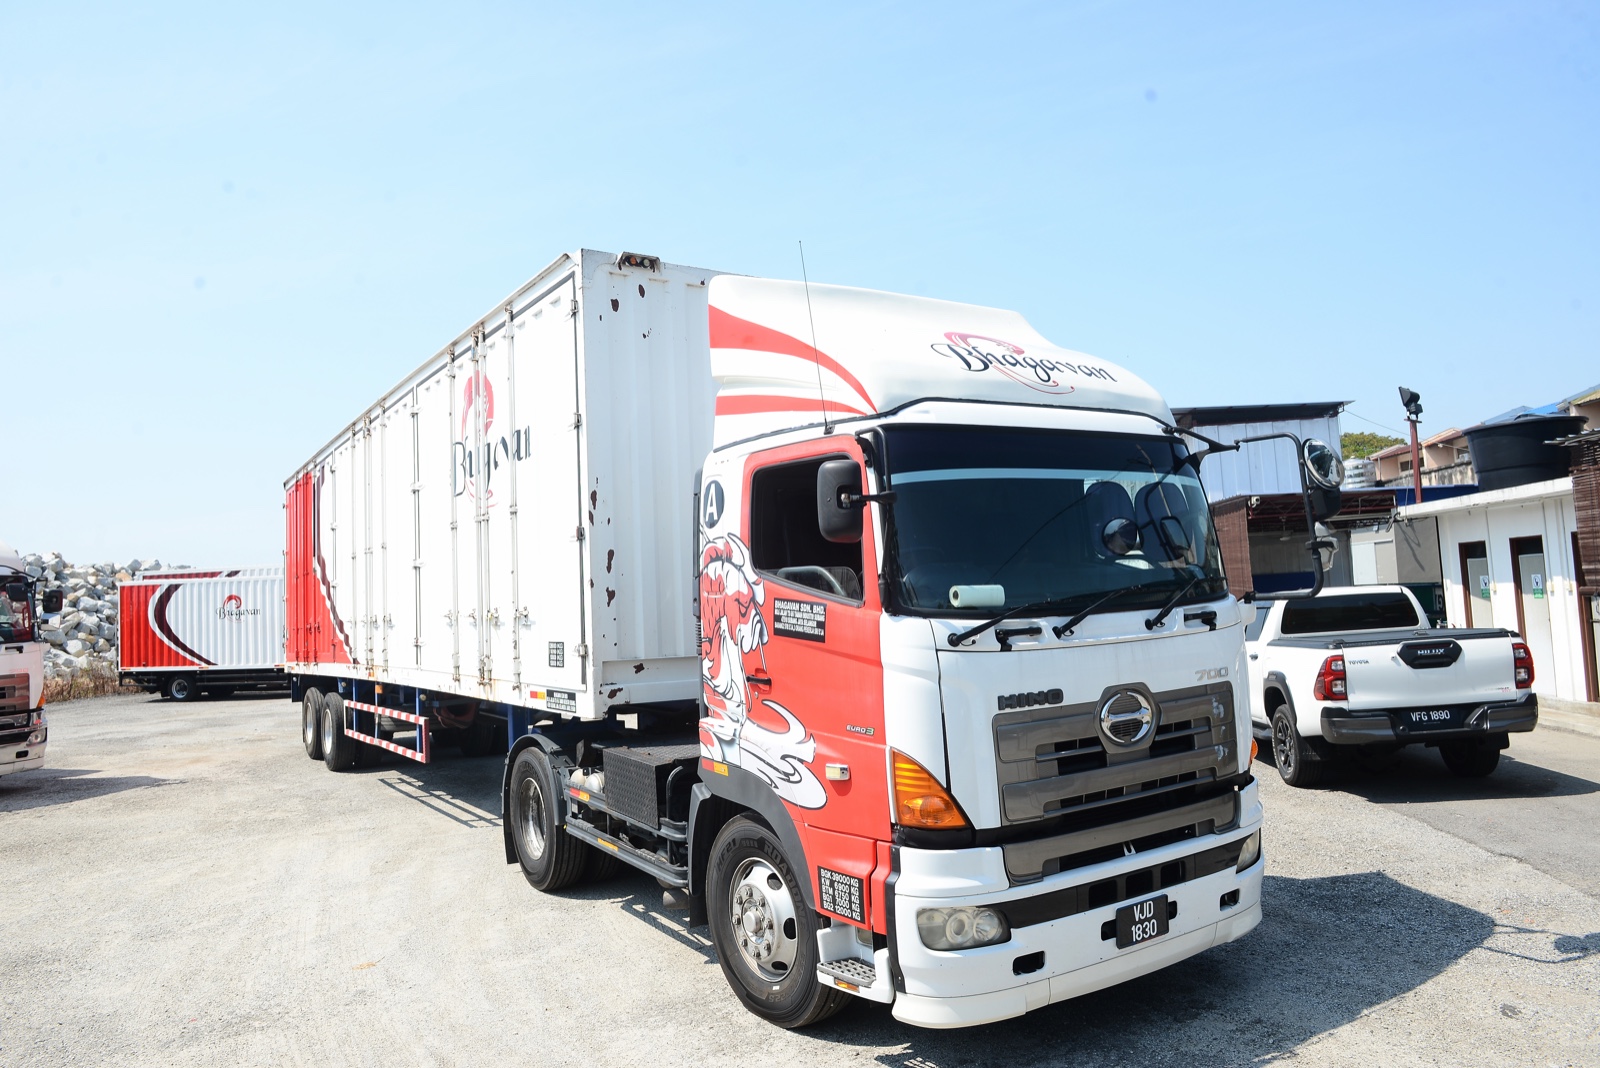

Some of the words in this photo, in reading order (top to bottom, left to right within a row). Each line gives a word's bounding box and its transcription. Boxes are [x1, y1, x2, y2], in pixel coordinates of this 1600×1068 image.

[930, 343, 1118, 383] Bhagavan
[705, 483, 719, 521] A
[774, 600, 800, 611] BHAGAVAN
[812, 604, 826, 614] BHD.
[1417, 648, 1445, 656] HILUX
[1195, 666, 1229, 681] 700
[998, 688, 1064, 710] HINO
[1410, 711, 1428, 722] VFG
[1429, 709, 1451, 720] 1890
[820, 868, 832, 879] BGK
[850, 877, 859, 887] KG
[821, 877, 830, 886] KW
[851, 886, 859, 896] KG
[822, 885, 834, 896] BTM
[851, 895, 860, 905] KG
[822, 893, 833, 903] BG1
[835, 898, 850, 909] 7000
[852, 902, 860, 913] KG
[823, 901, 835, 911] BG2
[835, 905, 852, 918] 12000
[852, 911, 861, 921] KG
[1133, 900, 1154, 922] VJD
[1131, 918, 1157, 942] 1830
